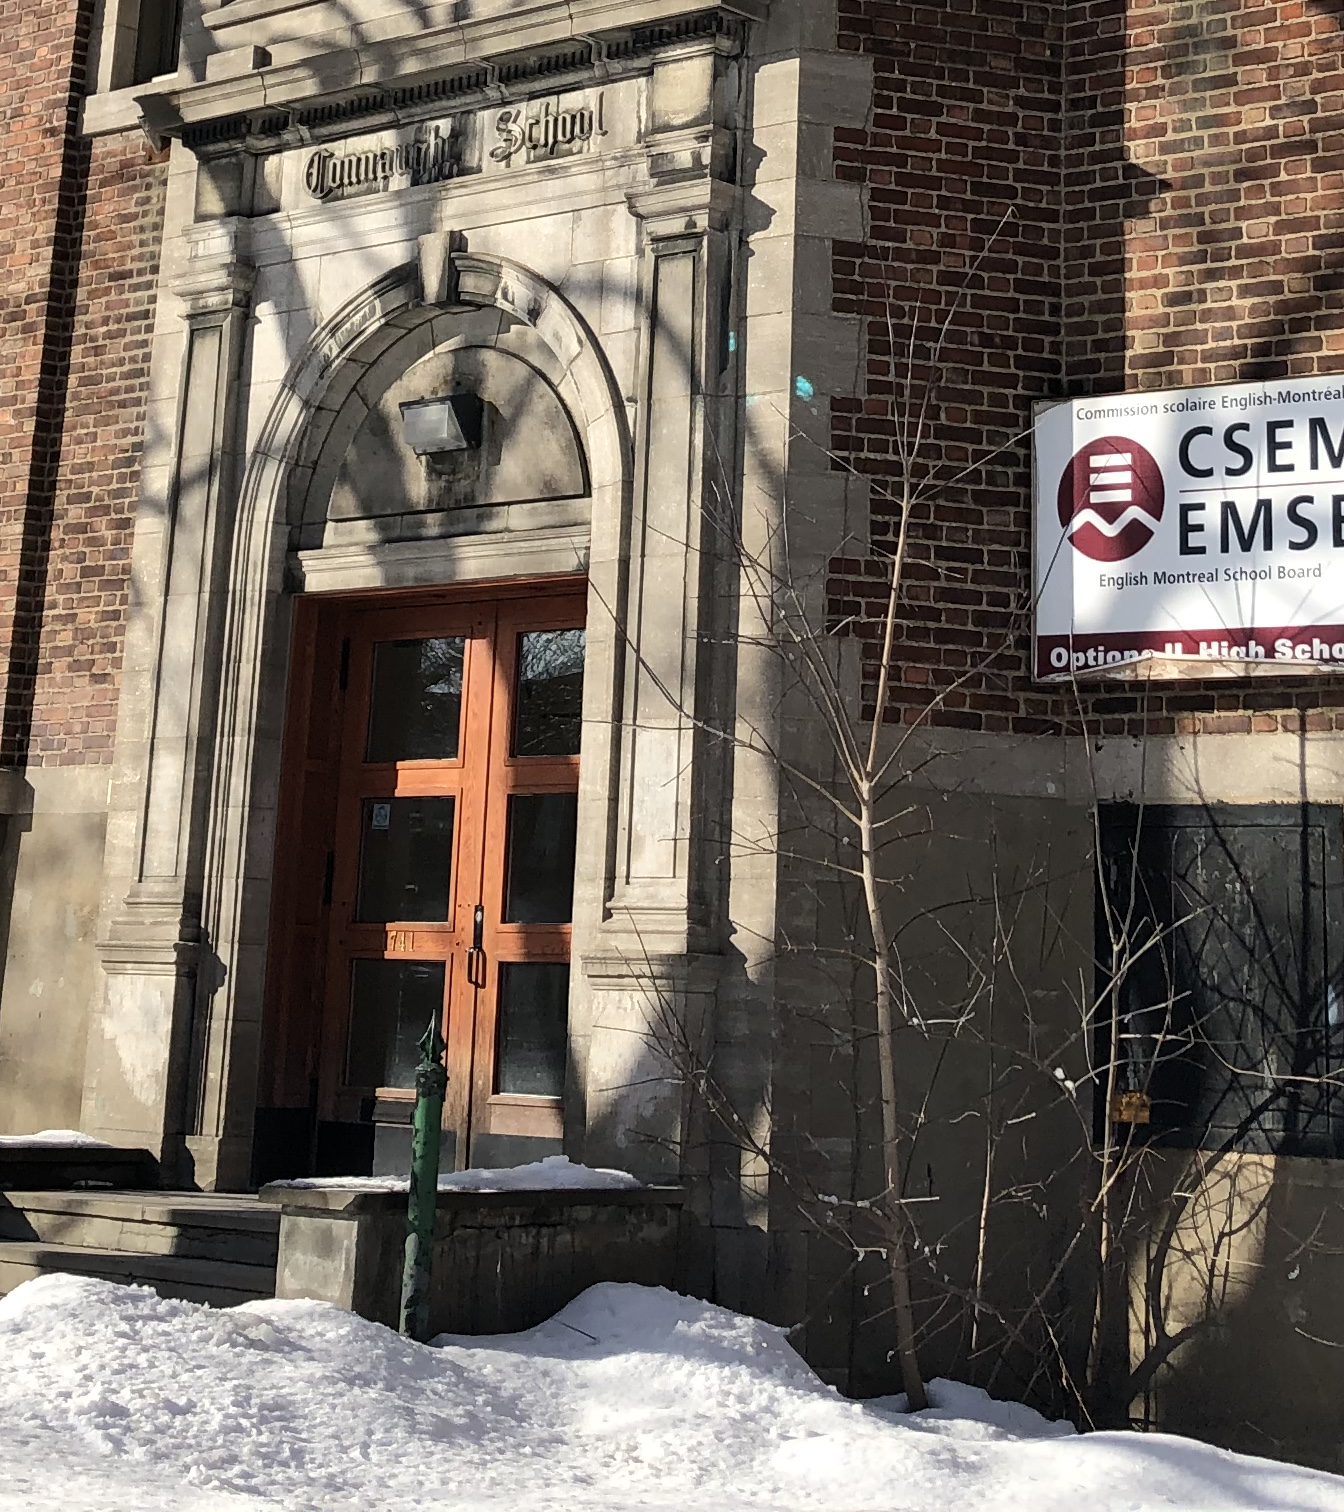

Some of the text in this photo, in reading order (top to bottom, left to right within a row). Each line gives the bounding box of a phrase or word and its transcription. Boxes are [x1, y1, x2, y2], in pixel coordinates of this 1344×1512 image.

[305, 91, 609, 199] Connaugh School
[1076, 403, 1158, 420] Commission
[1163, 397, 1216, 414] scolaire
[1099, 563, 1322, 590] English Montreal School Board
